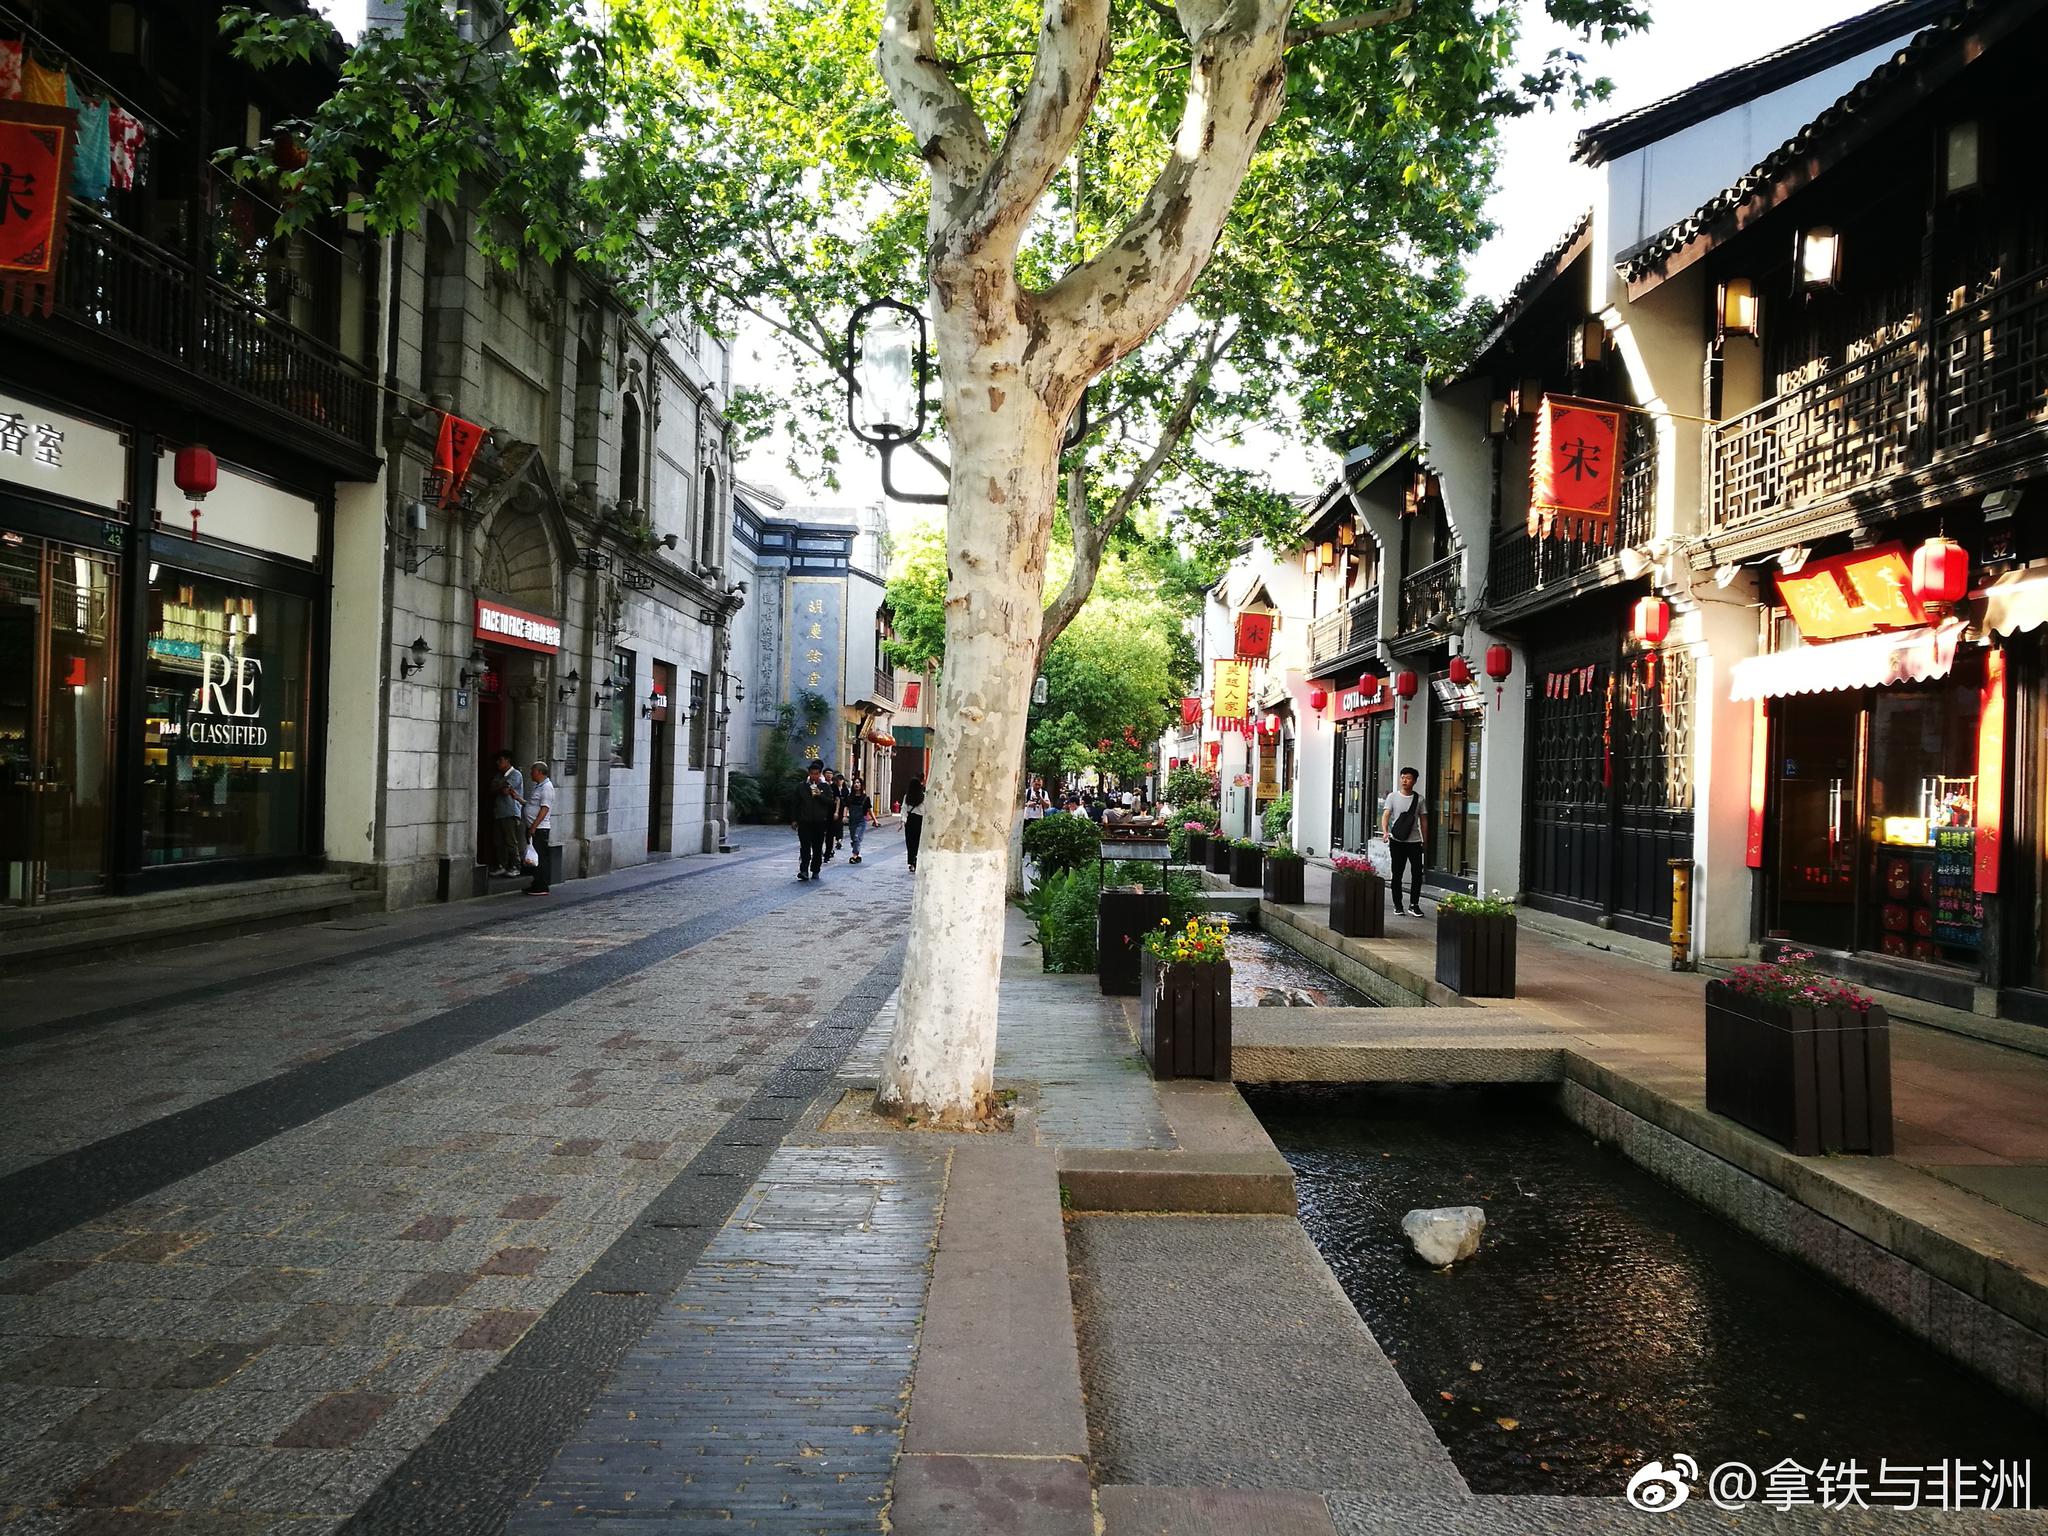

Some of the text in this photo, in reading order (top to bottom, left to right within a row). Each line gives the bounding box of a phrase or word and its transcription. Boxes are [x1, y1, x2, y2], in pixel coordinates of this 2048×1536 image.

[1560, 437, 1601, 482] 宋
[107, 534, 121, 546] 43
[1992, 543, 2007, 558] 32
[1246, 624, 1264, 643] 宋
[198, 650, 263, 718] RE
[1343, 691, 1360, 711] COSTA
[189, 721, 268, 746] CLASSIFIED
